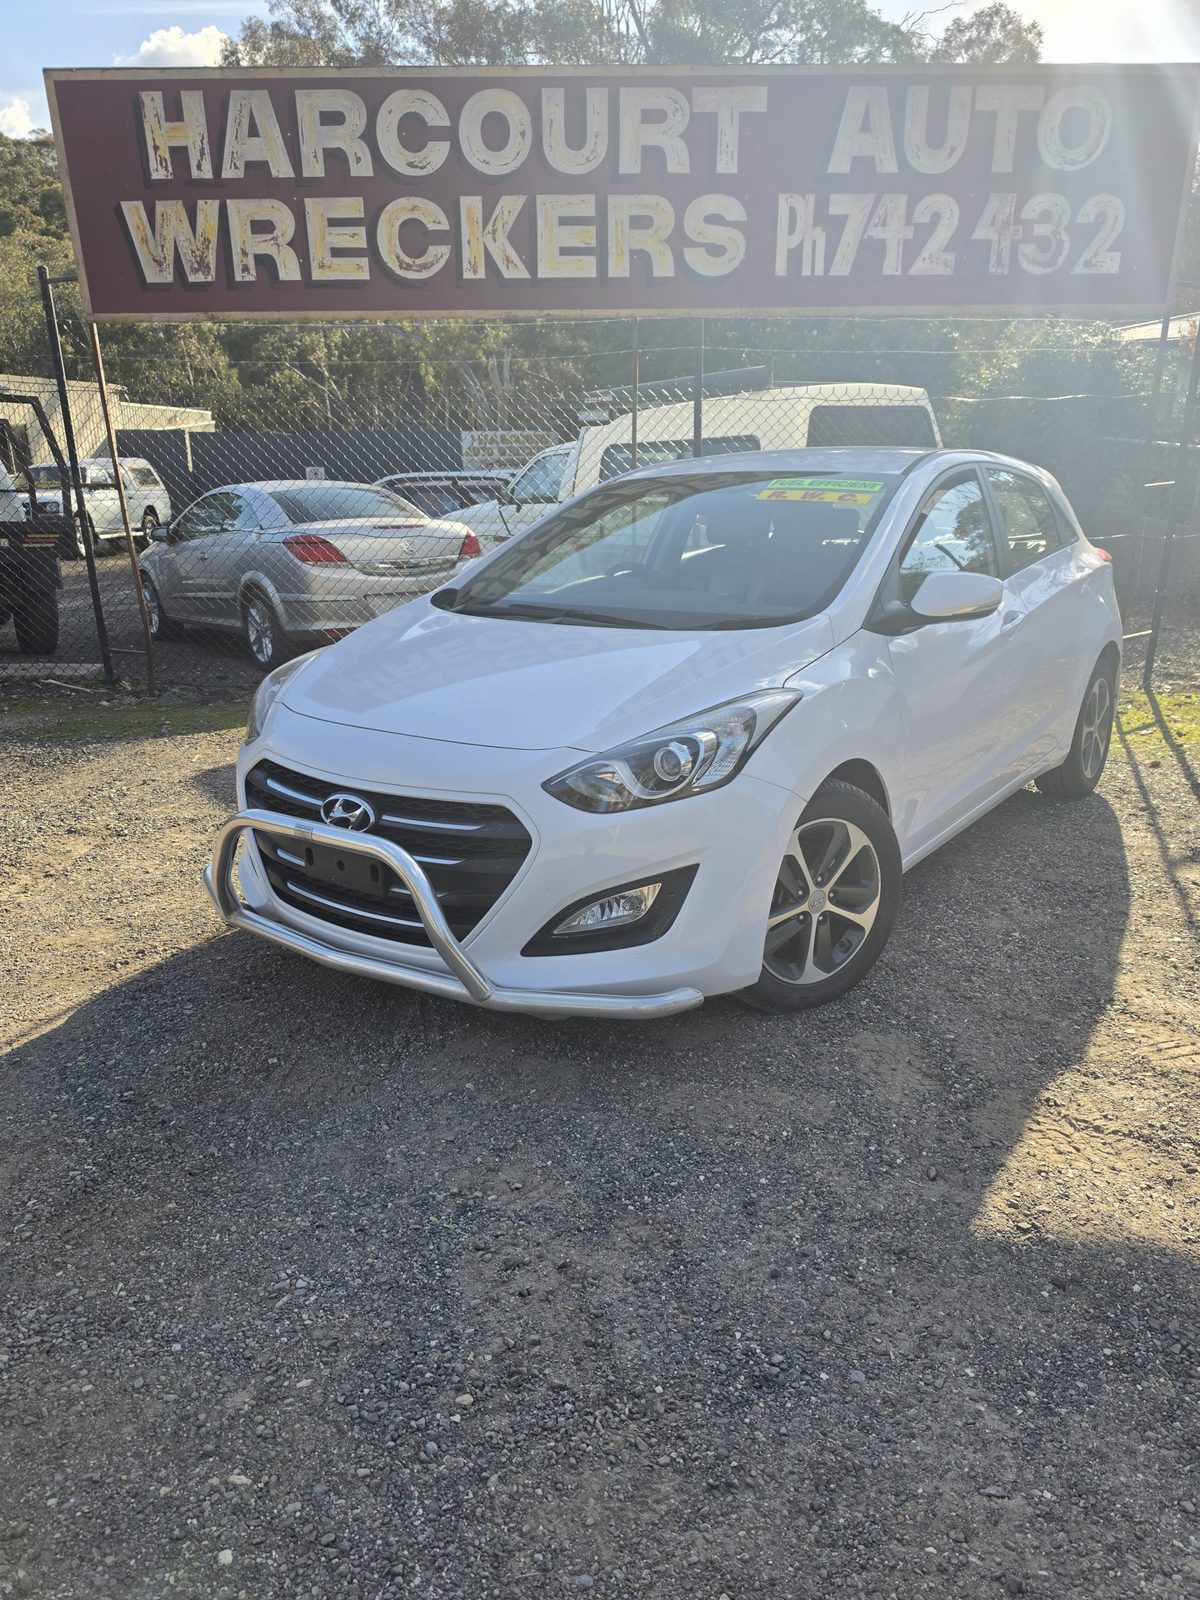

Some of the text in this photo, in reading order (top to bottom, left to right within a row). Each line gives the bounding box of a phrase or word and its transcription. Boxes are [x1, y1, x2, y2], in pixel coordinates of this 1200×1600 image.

[138, 84, 1113, 180] HARCOURT AUTO
[119, 193, 748, 283] WRECKERS
[807, 479, 880, 490] EFFICIENT
